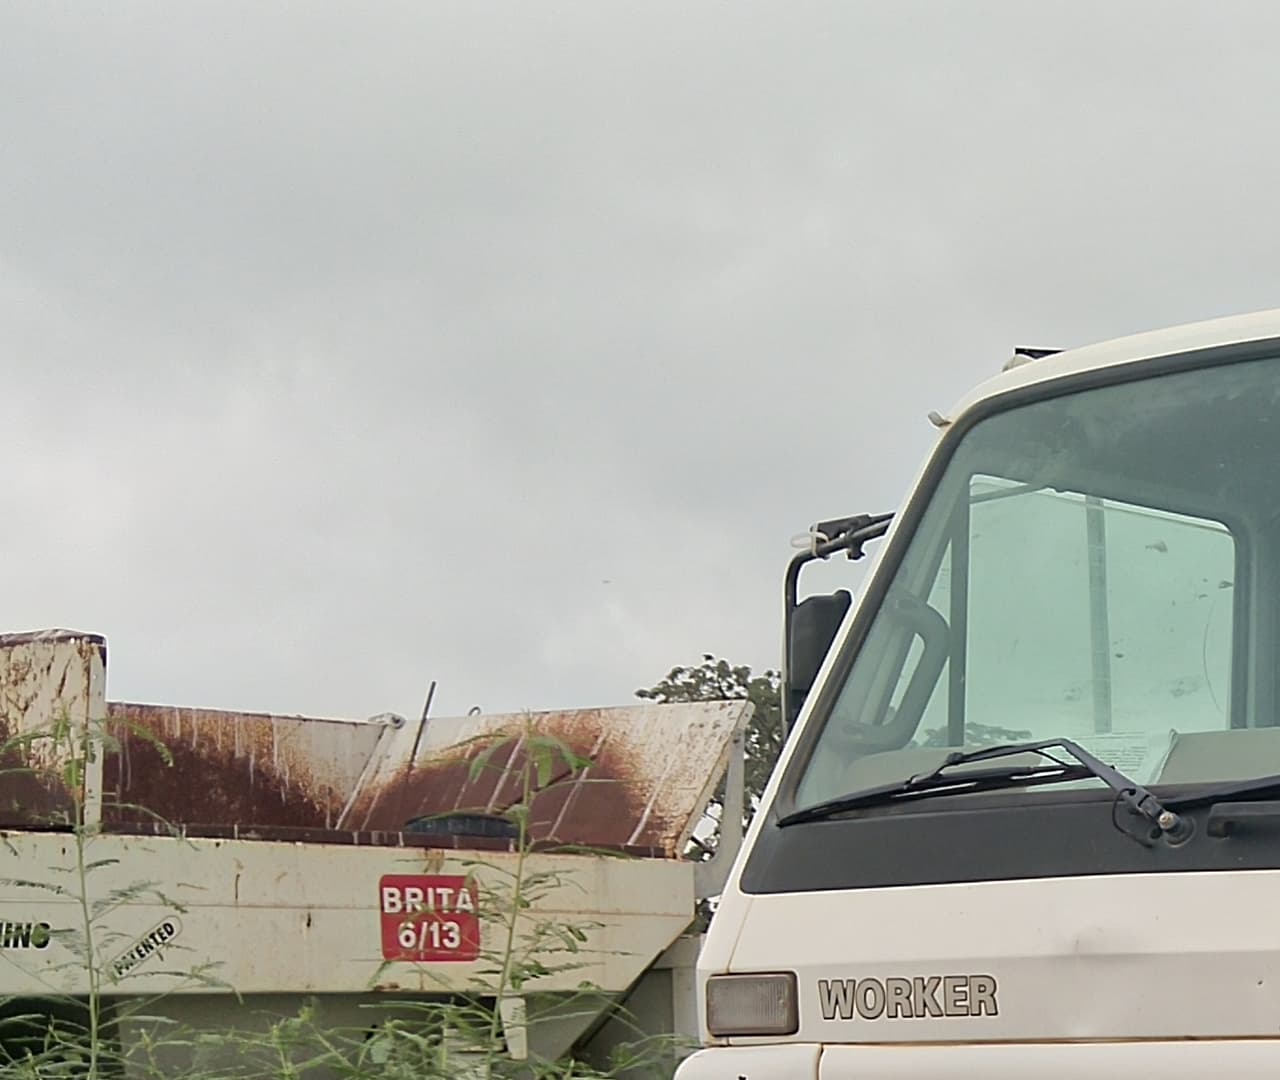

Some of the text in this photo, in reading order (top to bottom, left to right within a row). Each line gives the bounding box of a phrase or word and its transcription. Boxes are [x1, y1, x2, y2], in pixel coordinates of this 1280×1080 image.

[382, 887, 475, 914] BRITA
[0, 922, 50, 949] ING
[113, 922, 175, 976] PATENTED
[398, 920, 461, 951] 6/13
[818, 975, 999, 1020] WORKER
